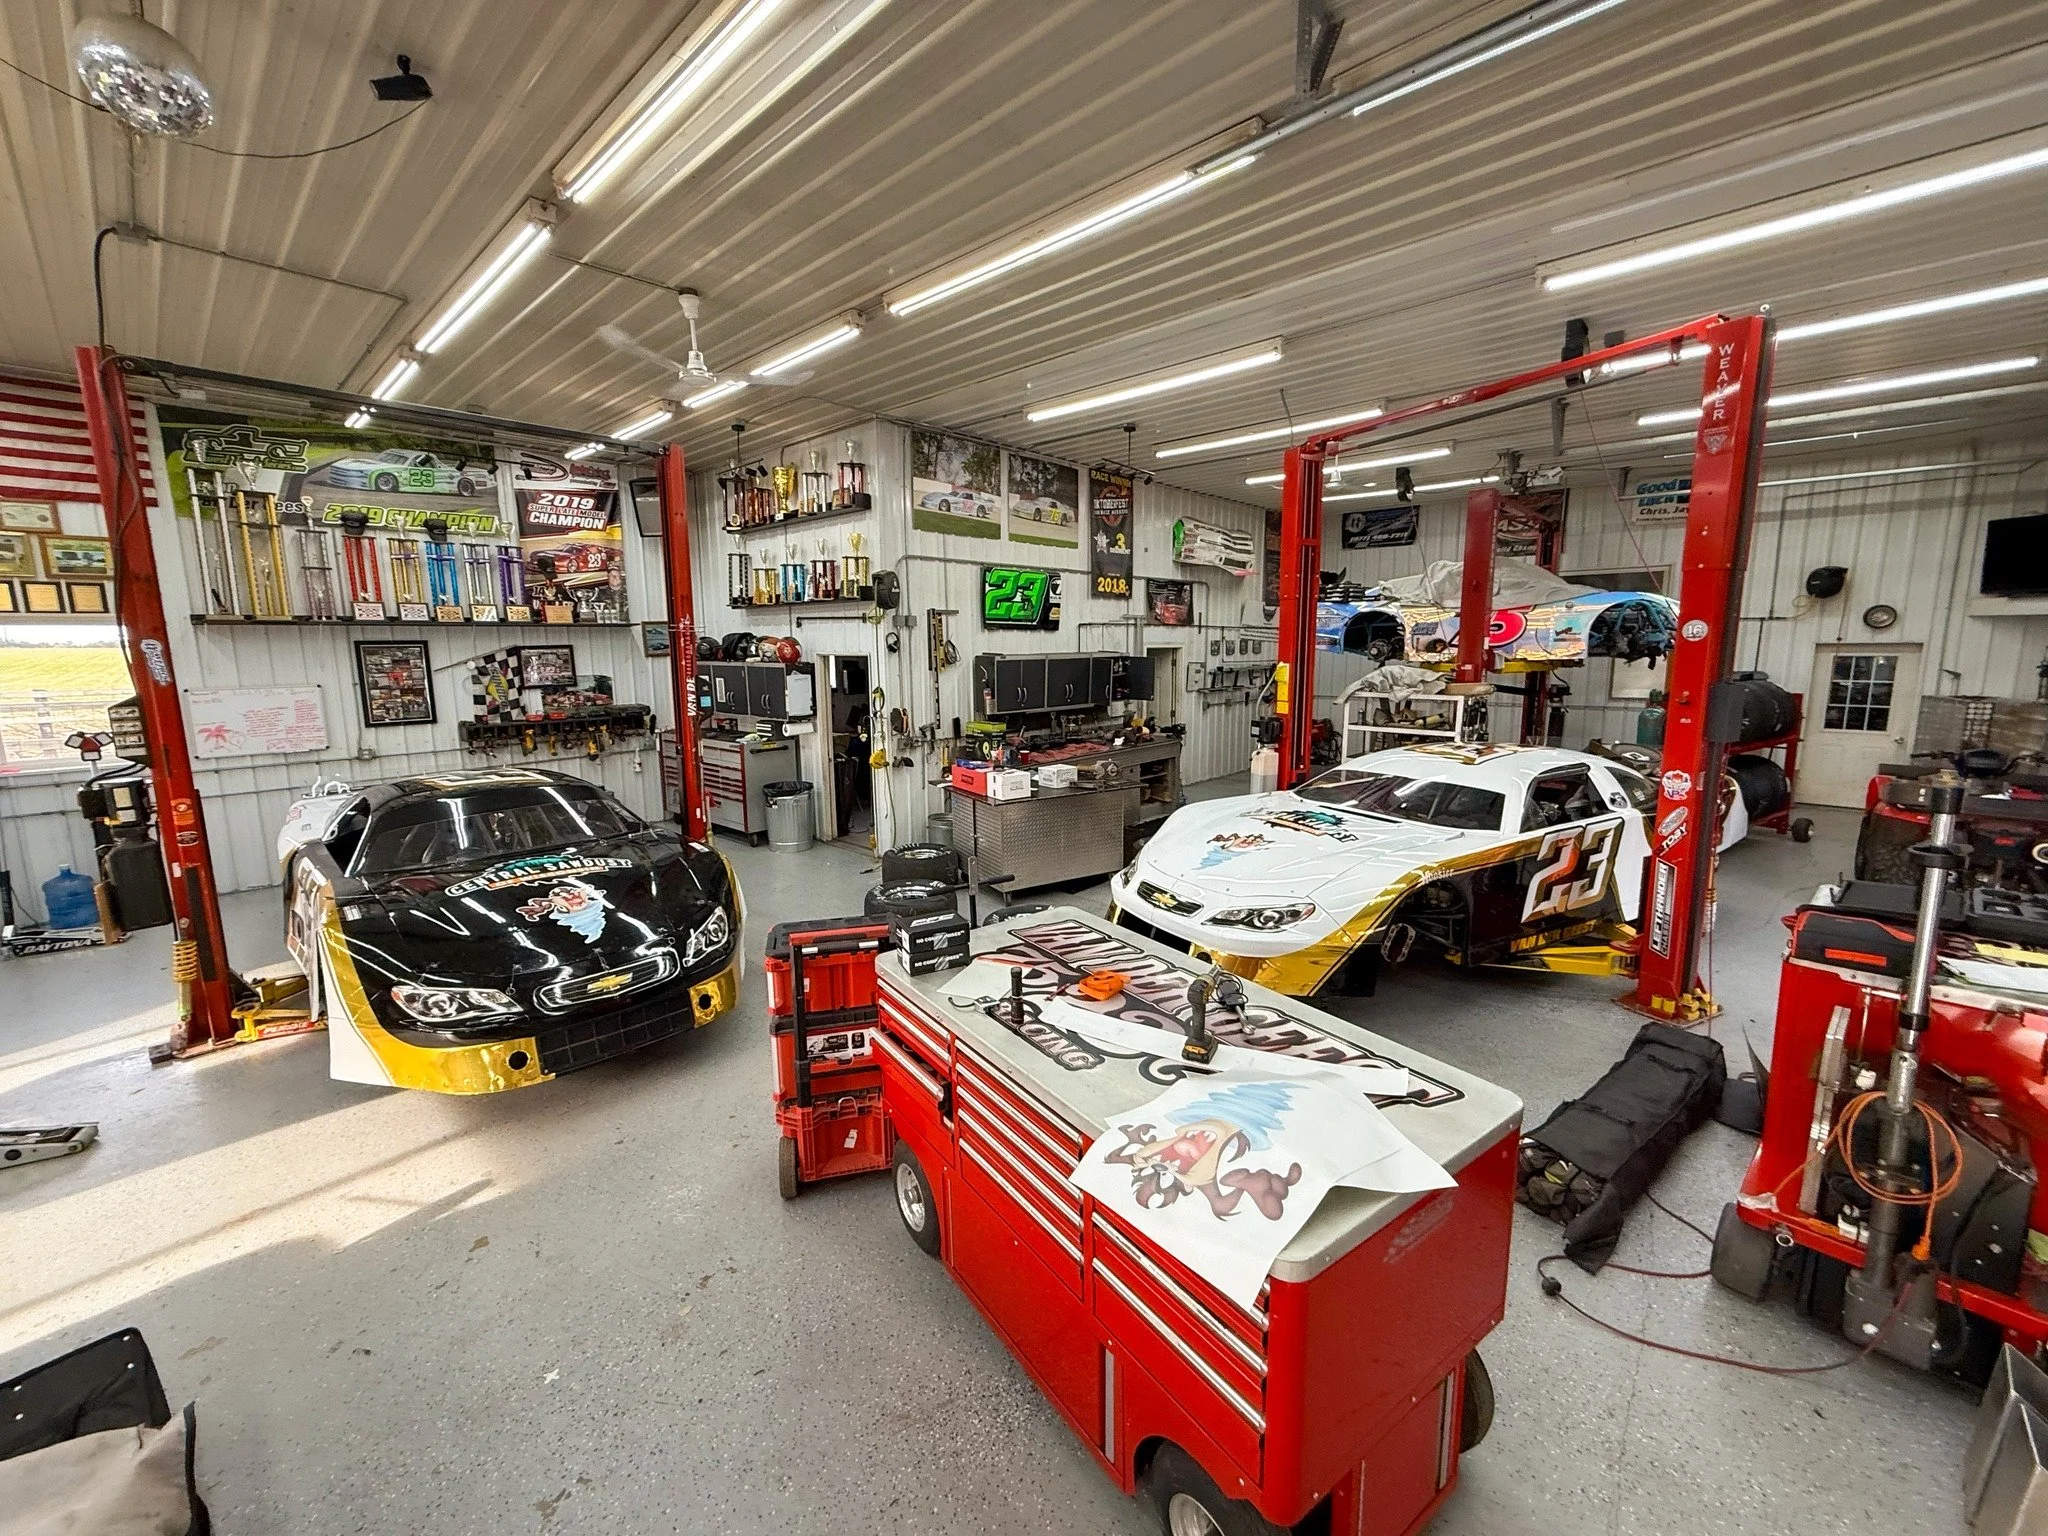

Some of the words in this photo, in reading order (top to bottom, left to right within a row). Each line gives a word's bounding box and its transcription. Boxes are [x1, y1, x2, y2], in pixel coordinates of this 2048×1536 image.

[1712, 343, 1735, 421] WEAVER
[409, 469, 435, 488] 23
[1091, 470, 1109, 481] RACE
[537, 492, 595, 510] 2019
[528, 503, 556, 514] SUPER
[557, 507, 577, 515] LATE
[580, 509, 605, 518] MODEL
[1640, 507, 1670, 515] Chris,
[529, 511, 605, 530] CHAMPION
[1115, 533, 1126, 550] 3
[588, 553, 601, 568] 23
[1097, 577, 1126, 593] 2018
[985, 568, 1048, 621] 23
[687, 693, 697, 717] VAN
[449, 865, 540, 895] CENTRAL
[543, 857, 632, 872] SAWDUST
[1521, 816, 1626, 924] 23
[1652, 861, 1670, 951] LEFTHANDER
[23, 938, 92, 954] DAYTONA
[1012, 919, 1142, 969] VAN
[1510, 935, 1537, 953] VAN
